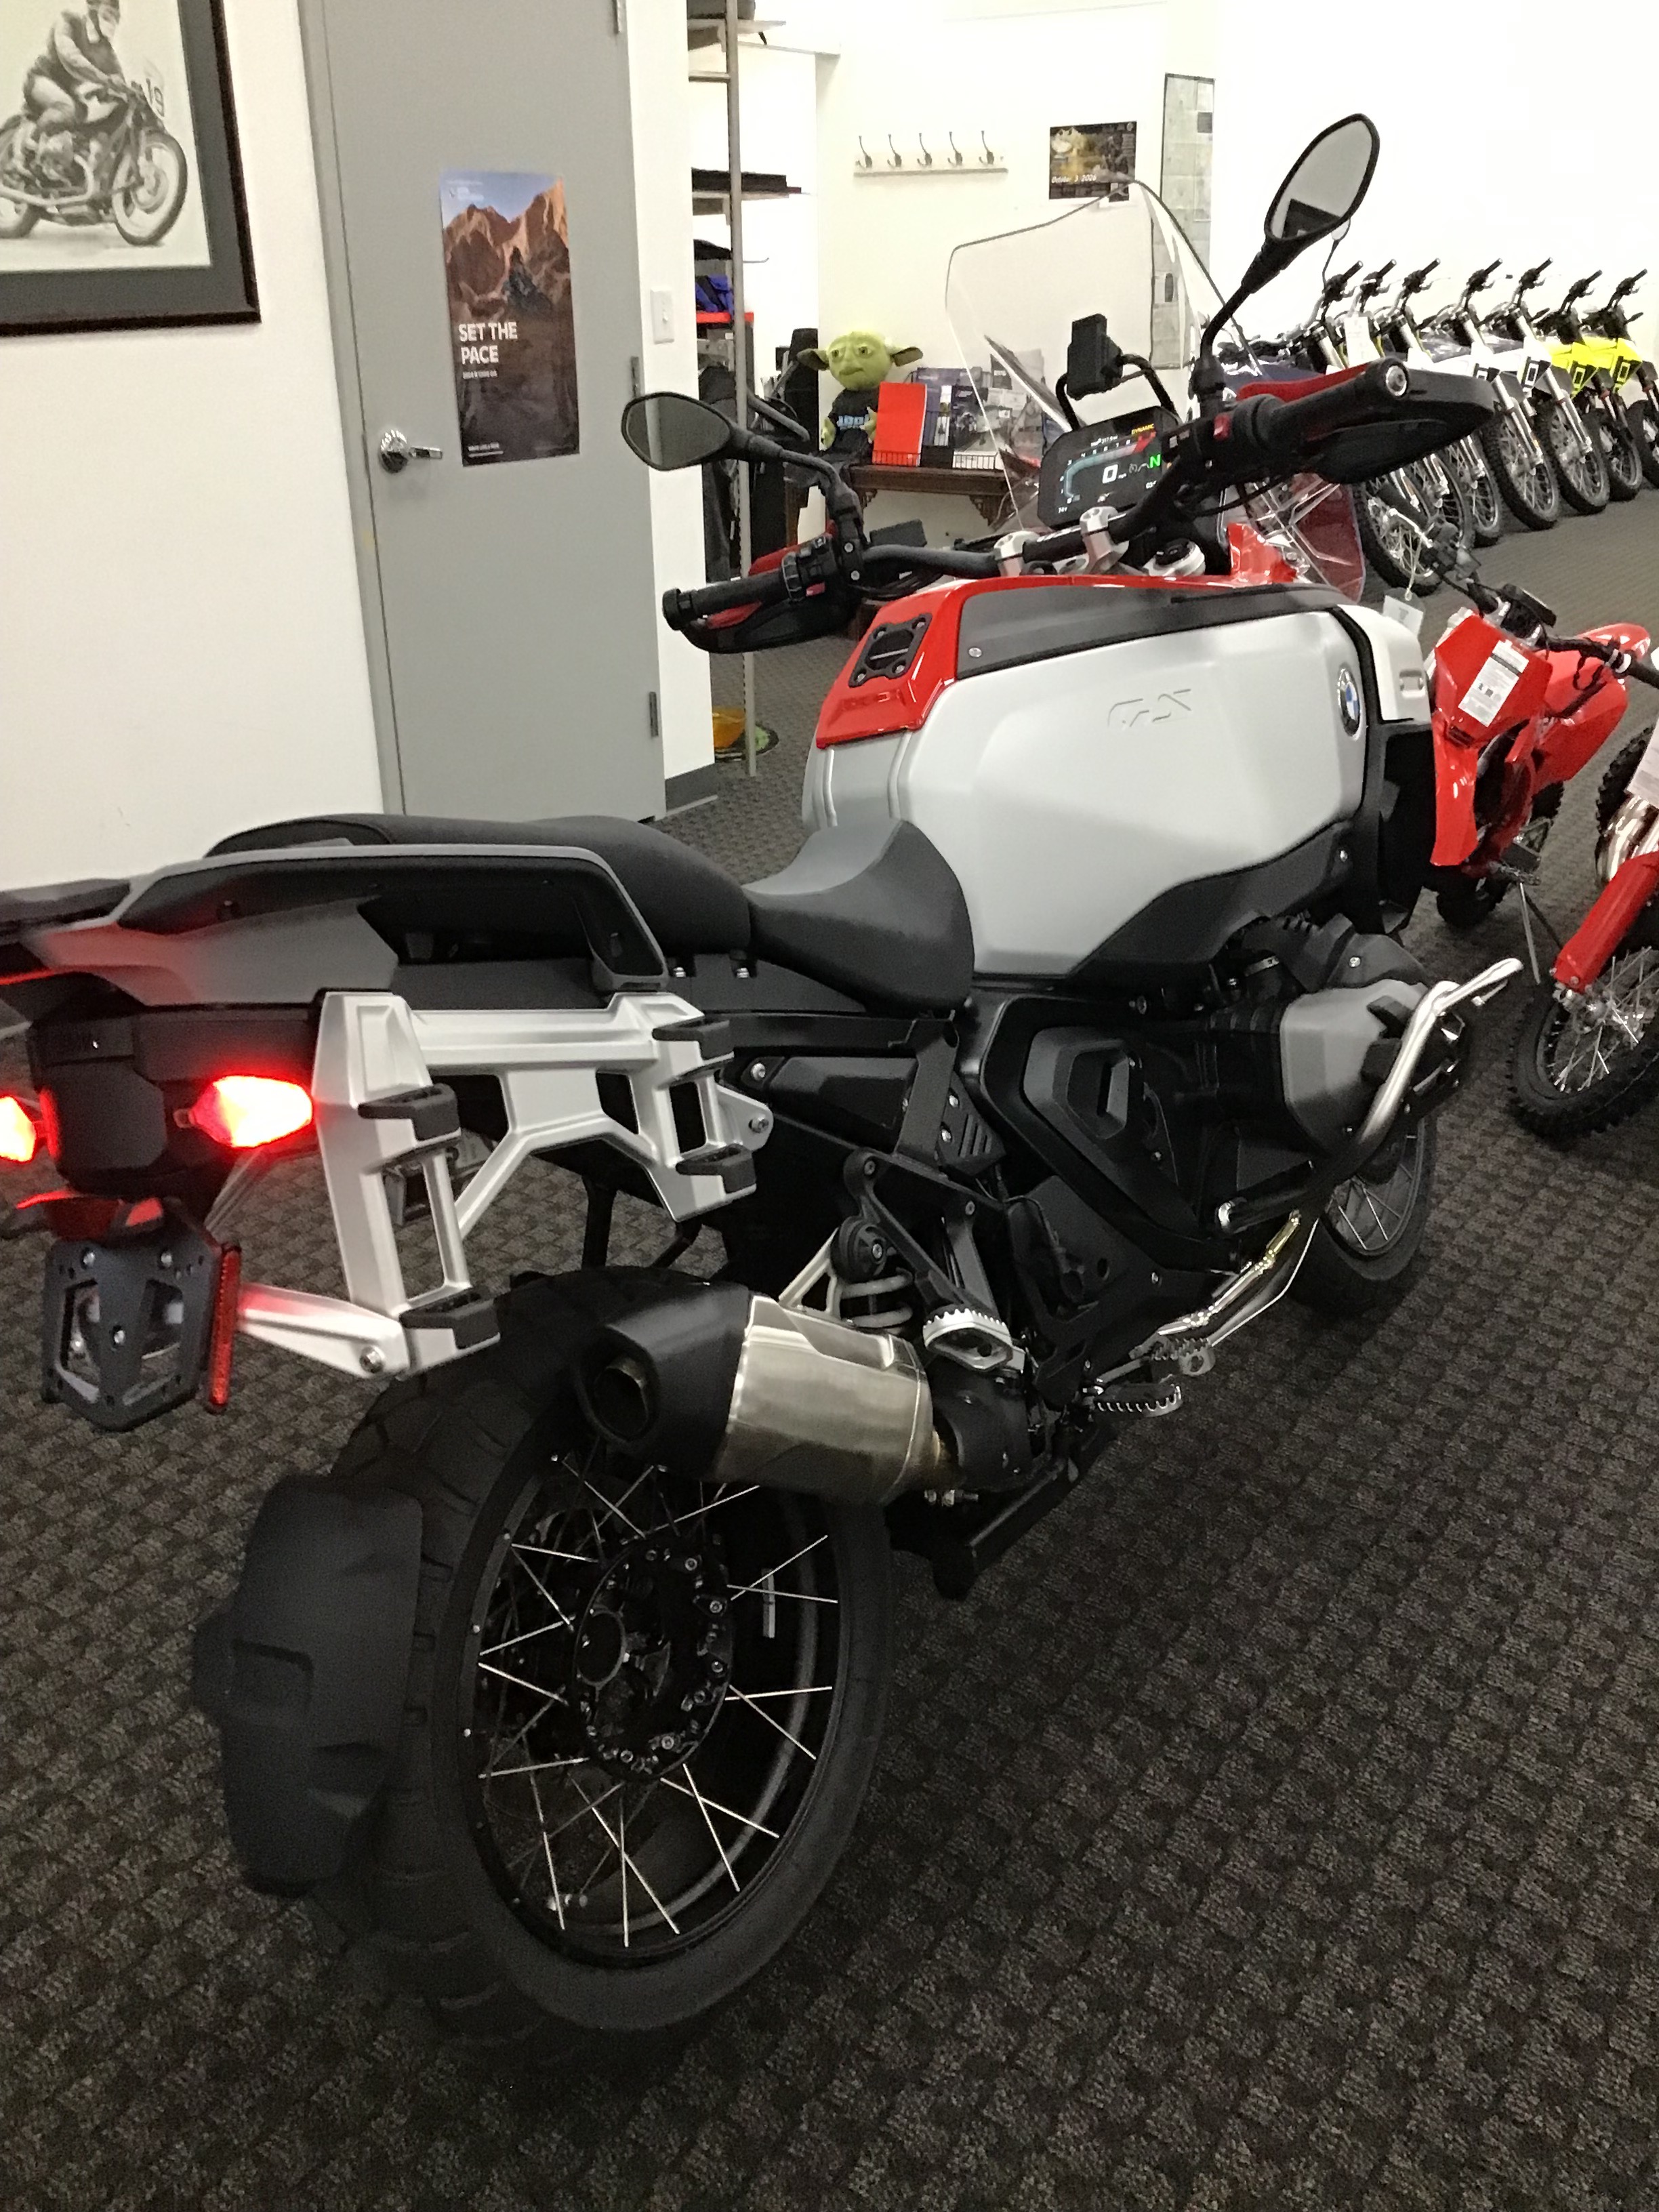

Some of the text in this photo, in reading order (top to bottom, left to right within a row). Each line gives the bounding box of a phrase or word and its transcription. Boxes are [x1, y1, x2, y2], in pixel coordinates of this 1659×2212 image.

[146, 77, 165, 117] 19
[458, 321, 518, 342] SET THE
[461, 345, 499, 365] PACE
[1149, 454, 1161, 468] N
[1103, 464, 1118, 483] 0
[1107, 688, 1192, 730] GS
